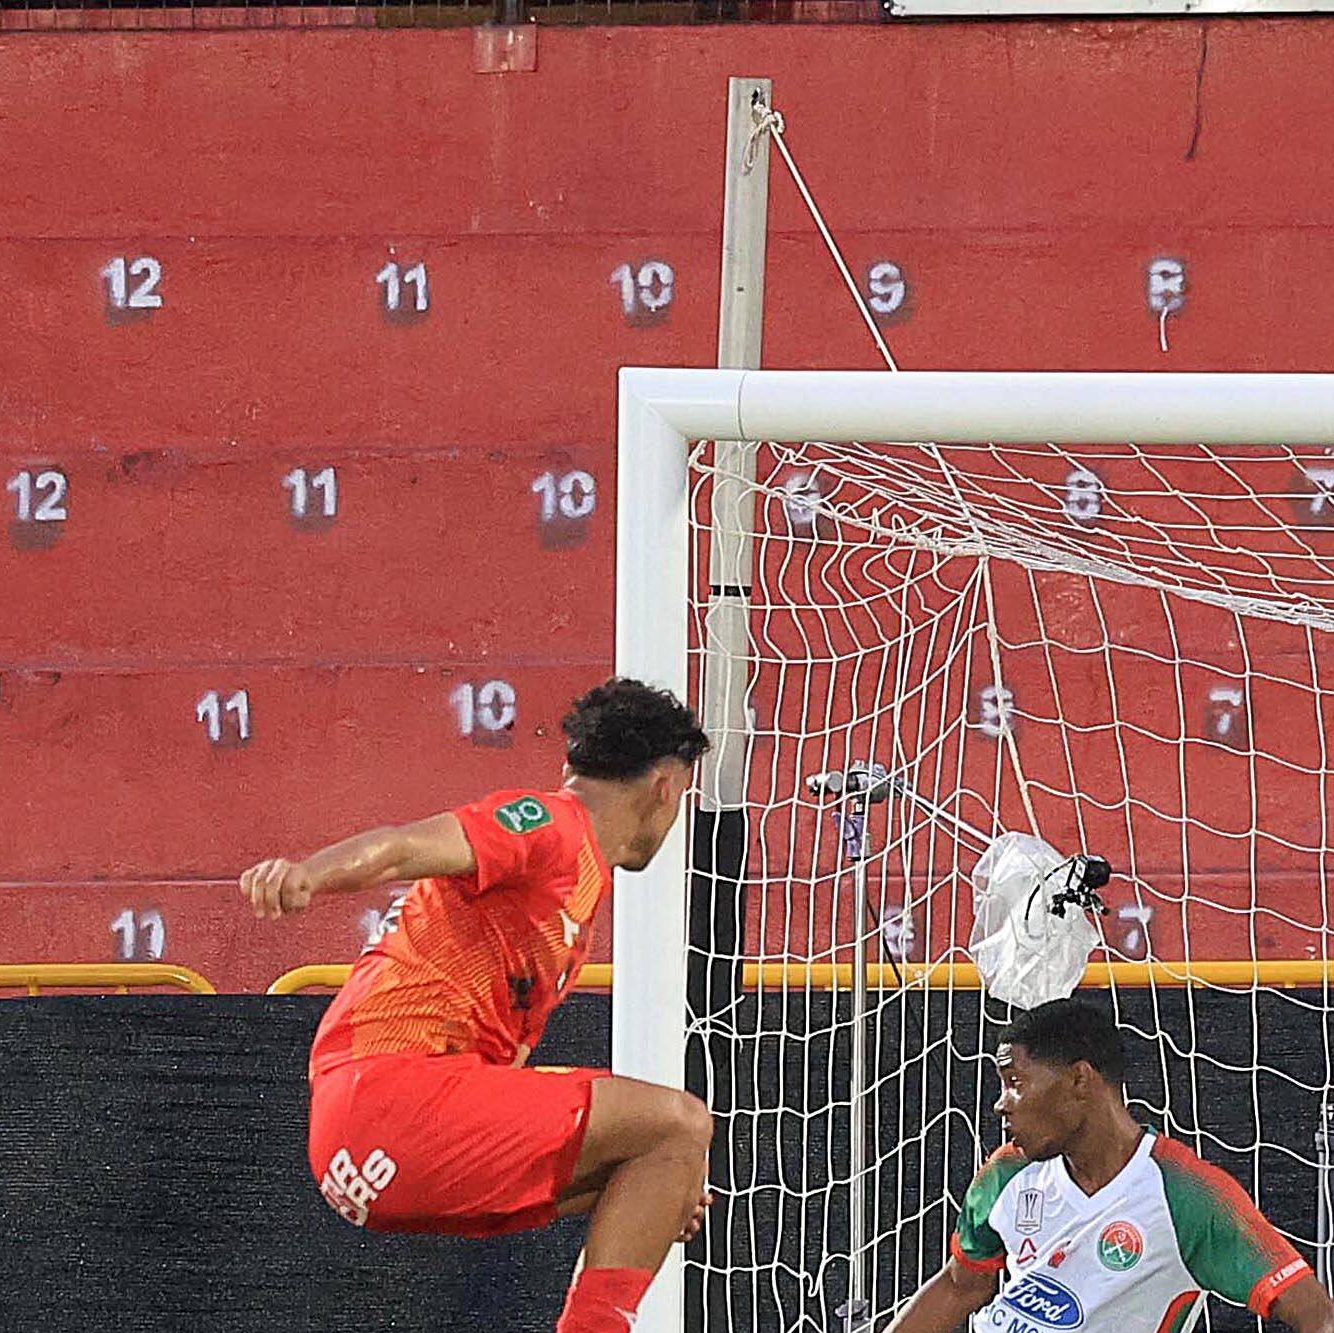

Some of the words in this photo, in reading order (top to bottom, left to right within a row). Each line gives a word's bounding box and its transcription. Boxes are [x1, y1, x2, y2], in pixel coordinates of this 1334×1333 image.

[103, 256, 162, 308] 12
[376, 261, 428, 311] 11
[611, 261, 673, 312] 10
[868, 262, 906, 313] 9
[1148, 259, 1186, 311] 8
[7, 472, 66, 521] 12
[283, 468, 337, 516] 11
[533, 470, 595, 520] 10
[1066, 469, 1104, 519] 8
[196, 690, 250, 742] 11
[451, 680, 516, 735] 10
[1209, 687, 1243, 736] 7
[112, 911, 165, 962] 11
[1118, 905, 1153, 955] 7
